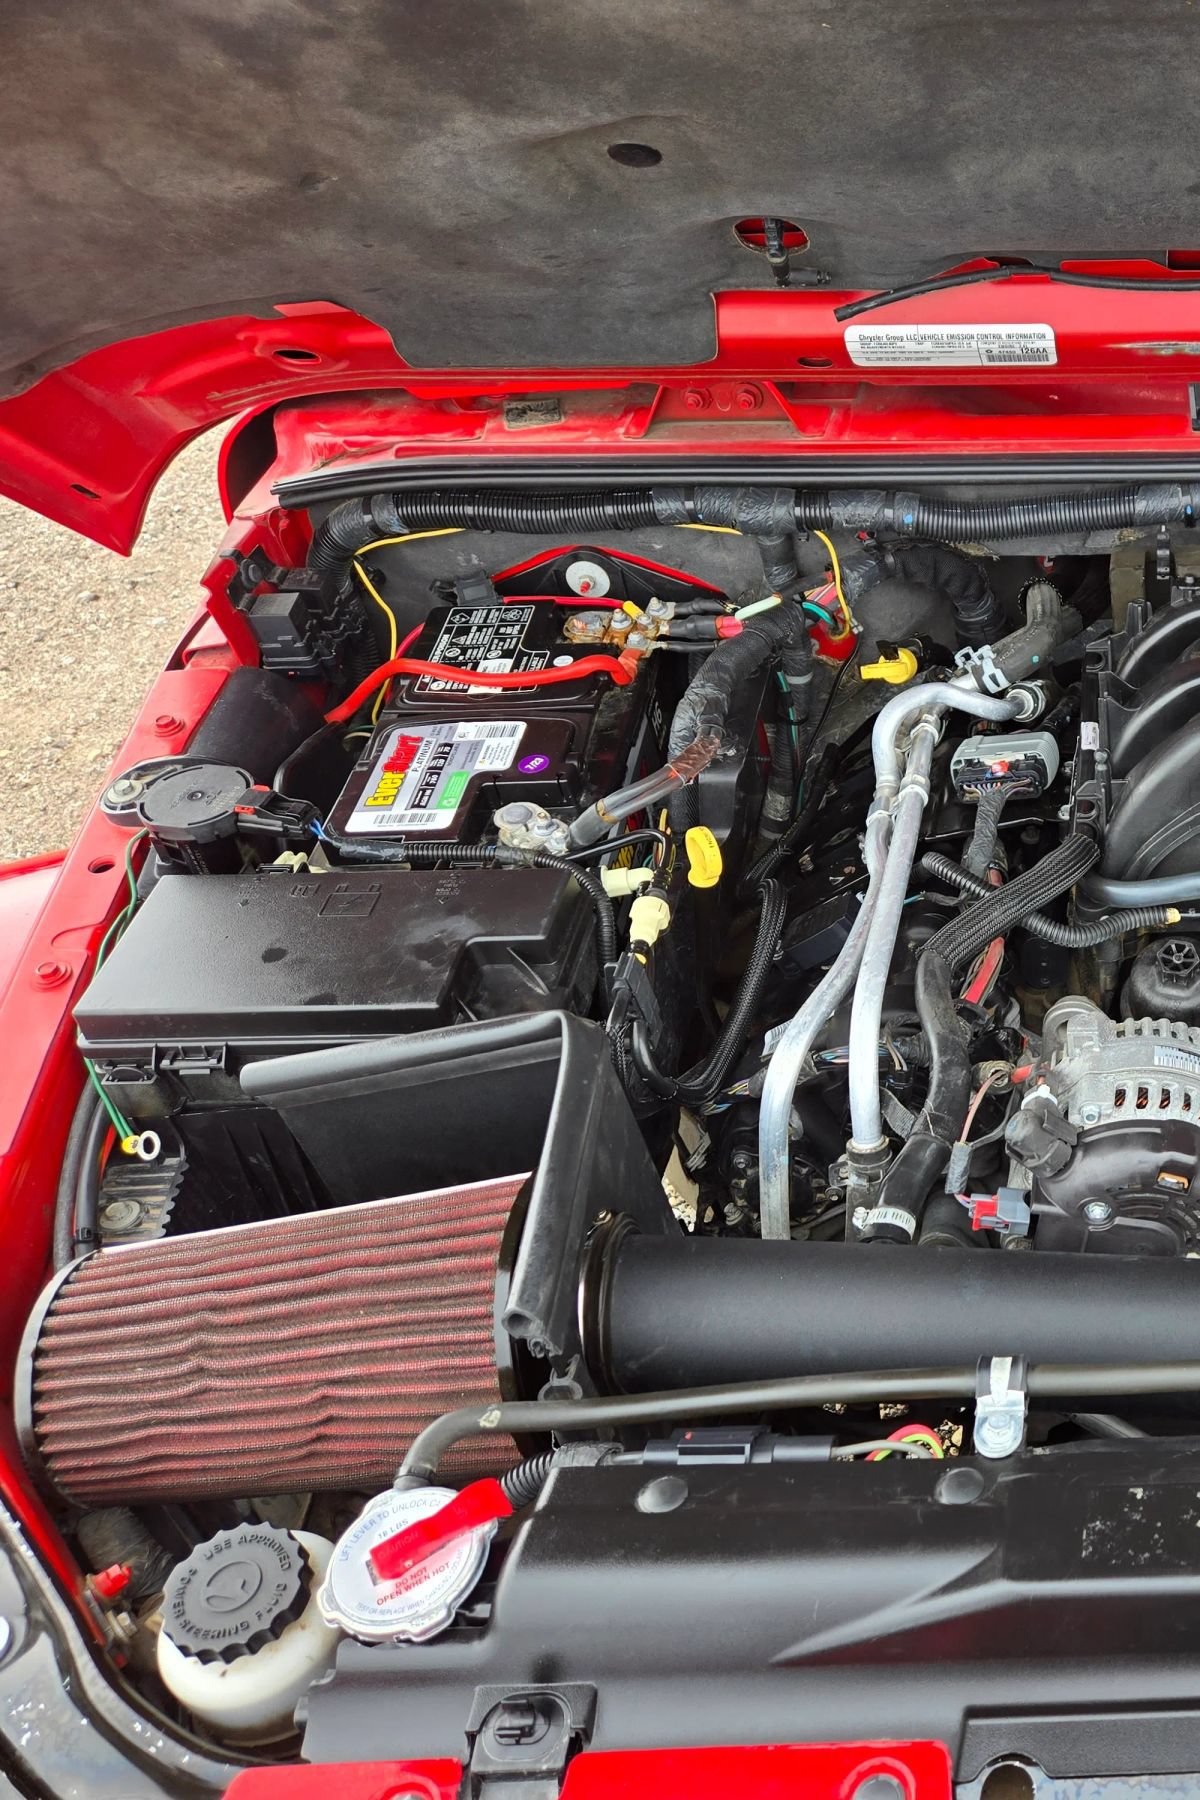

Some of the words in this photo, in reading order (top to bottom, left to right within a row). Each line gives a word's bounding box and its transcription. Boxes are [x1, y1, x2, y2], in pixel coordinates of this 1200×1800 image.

[858, 334, 884, 342] Chrysler
[886, 334, 905, 342] Group
[364, 732, 422, 808] EverStart
[411, 739, 435, 773] PLATINUM
[338, 1542, 353, 1562] LIFT
[352, 1518, 378, 1544] LEVER
[378, 1510, 390, 1521] TO
[392, 1498, 428, 1514] UNLOCK
[204, 1538, 233, 1560] USE
[237, 1533, 292, 1572] APPROVED
[172, 1567, 198, 1620] POWER
[376, 1588, 402, 1606] OPEN
[404, 1575, 431, 1592] WHEN
[432, 1562, 450, 1577] HOT
[395, 1576, 409, 1590] DO
[410, 1566, 428, 1582] NOT
[254, 1582, 288, 1621] FLUID
[379, 1606, 406, 1616] REPLACE
[407, 1600, 426, 1612] WHEN
[179, 1619, 251, 1640] STEERING
